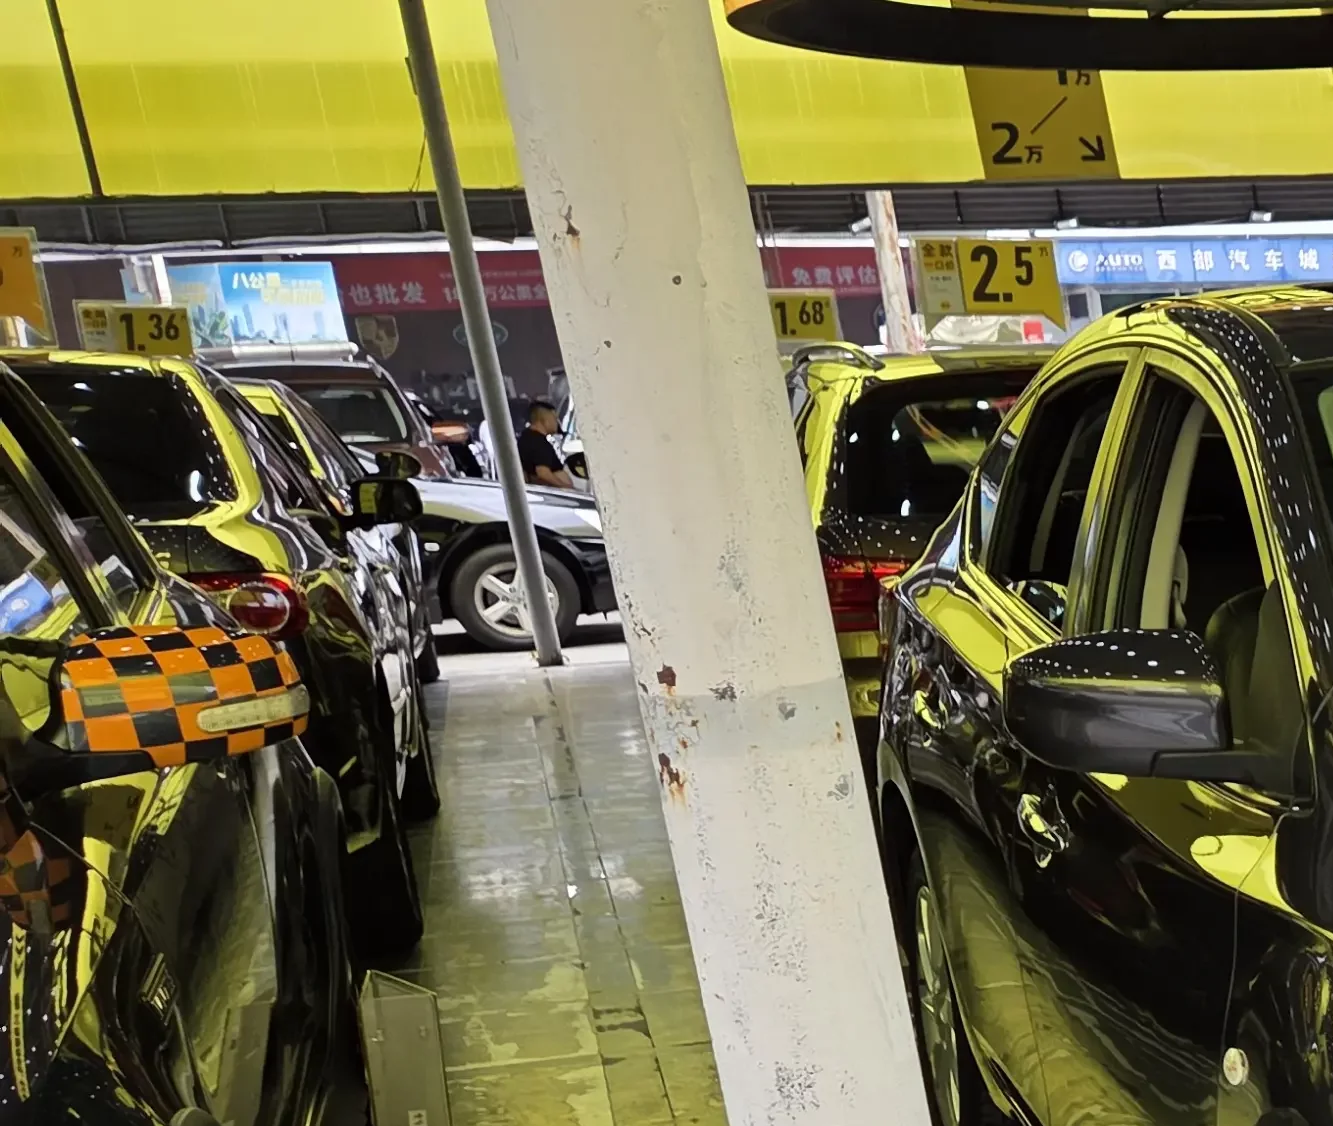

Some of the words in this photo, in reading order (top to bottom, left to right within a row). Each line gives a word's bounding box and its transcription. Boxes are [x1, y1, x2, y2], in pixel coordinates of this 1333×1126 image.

[991, 122, 1044, 164] 2万
[792, 265, 877, 286] 免费评估
[339, 281, 427, 306] 也批发
